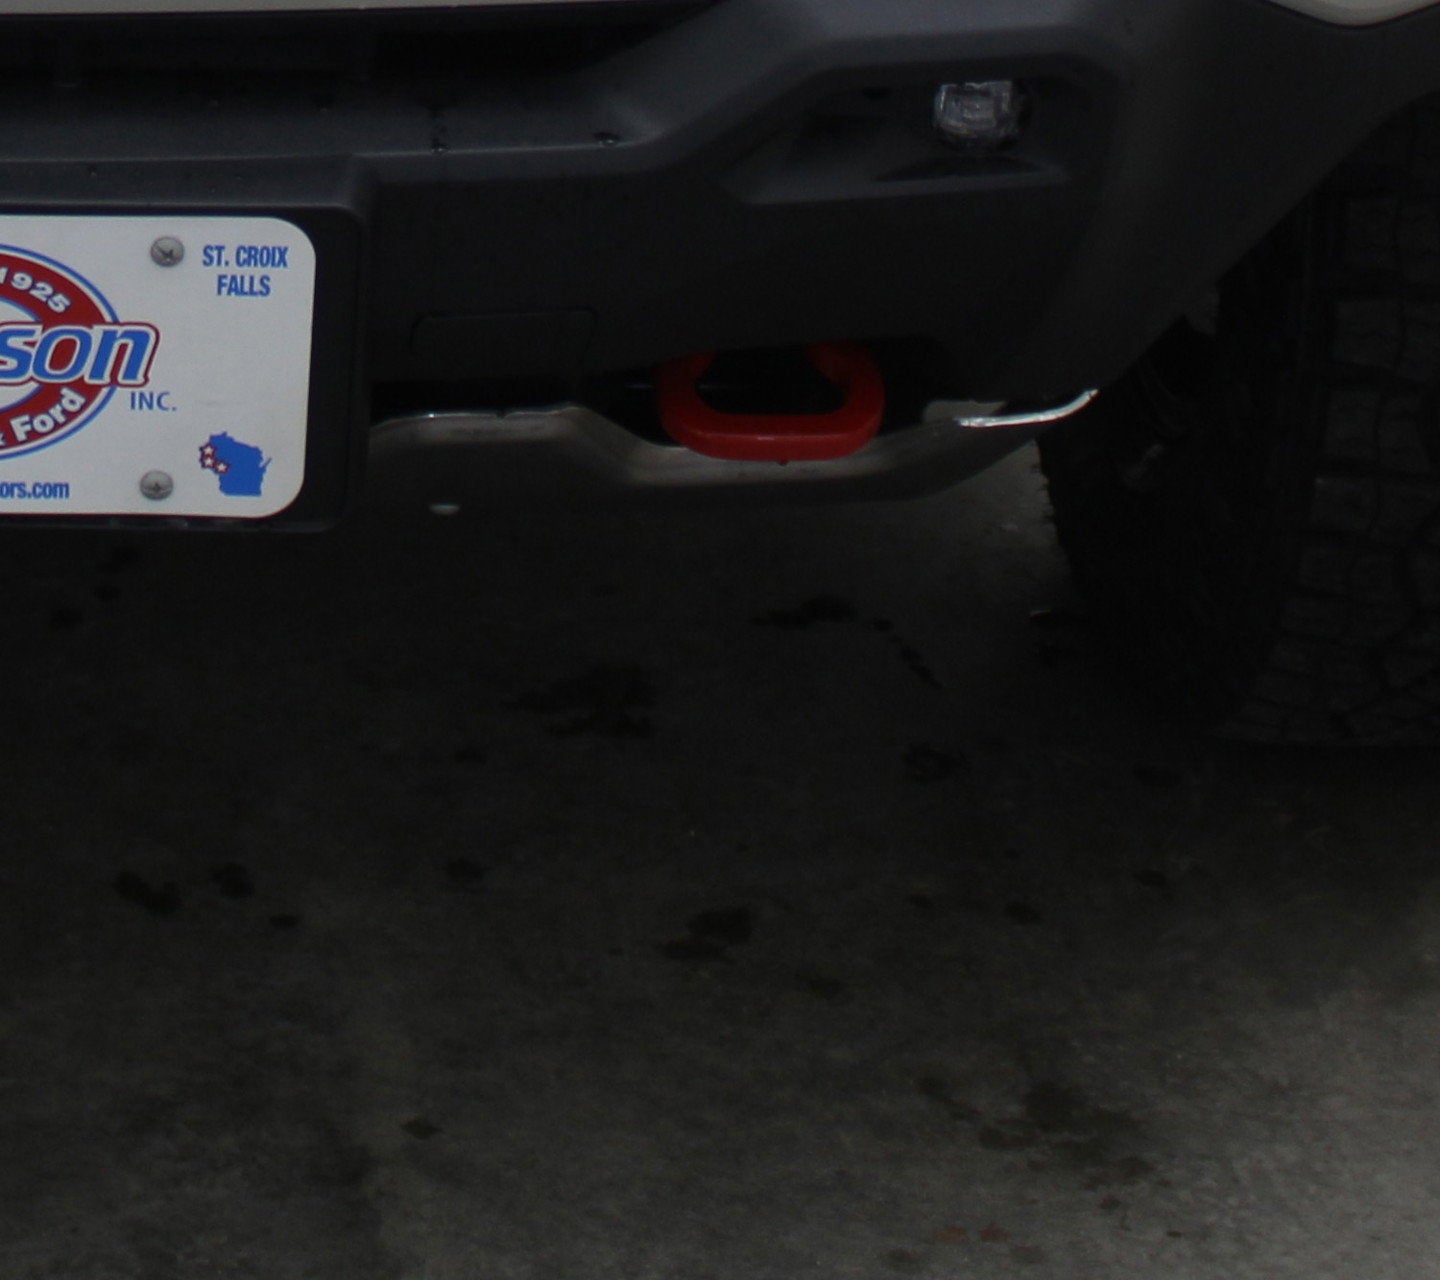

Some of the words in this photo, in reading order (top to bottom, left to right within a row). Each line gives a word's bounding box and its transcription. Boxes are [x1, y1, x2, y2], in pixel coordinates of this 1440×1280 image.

[202, 245, 229, 267] ST.
[235, 246, 288, 268] CROIX
[217, 274, 271, 297] FALLS
[129, 392, 178, 412] INC.
[10, 387, 87, 444] Ford
